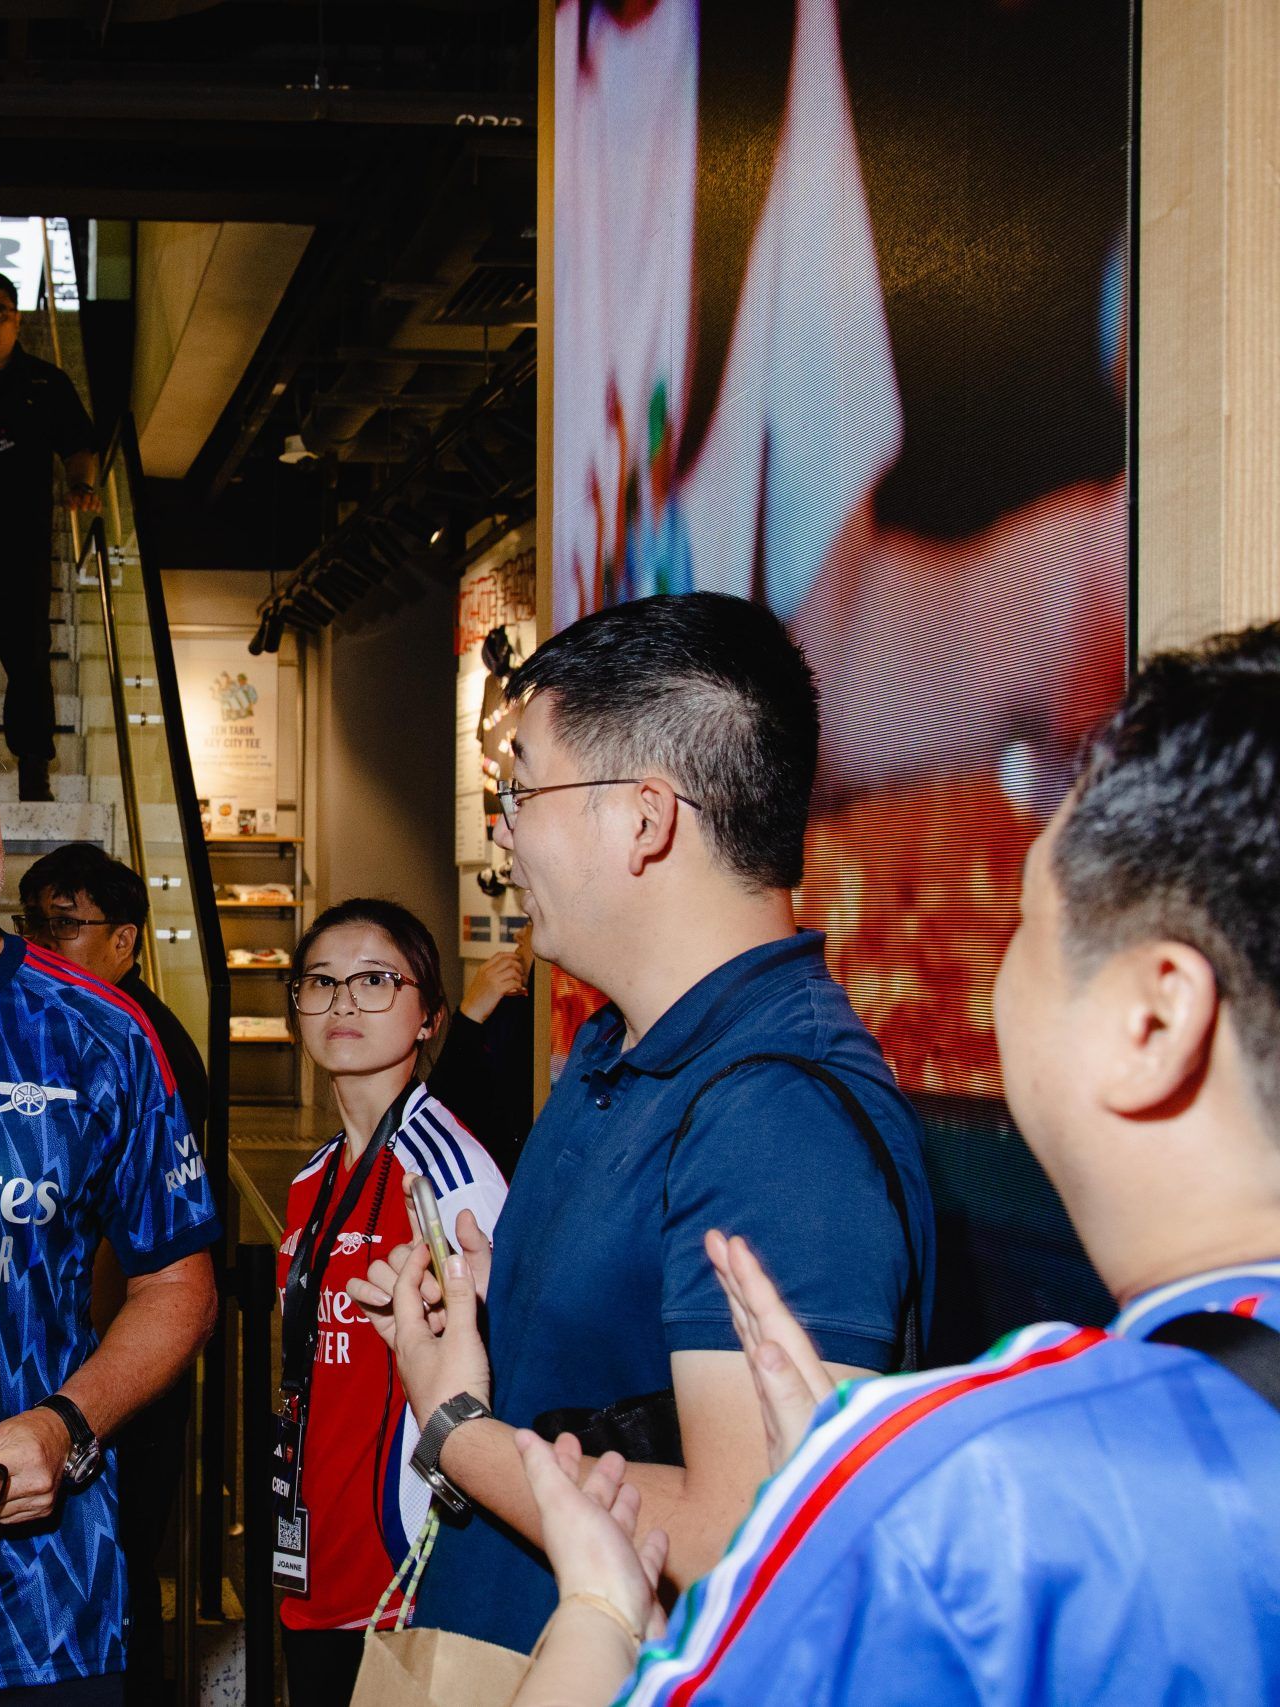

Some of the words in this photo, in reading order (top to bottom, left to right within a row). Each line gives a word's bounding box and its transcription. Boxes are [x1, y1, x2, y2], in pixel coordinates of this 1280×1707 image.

[229, 726, 255, 737] TARIK
[223, 738, 243, 748] CITY
[245, 738, 261, 749] TEE
[174, 1132, 198, 1158] VI
[165, 1154, 206, 1193] RWA
[272, 1476, 291, 1498] CREW
[277, 1559, 302, 1572] JOANNE
